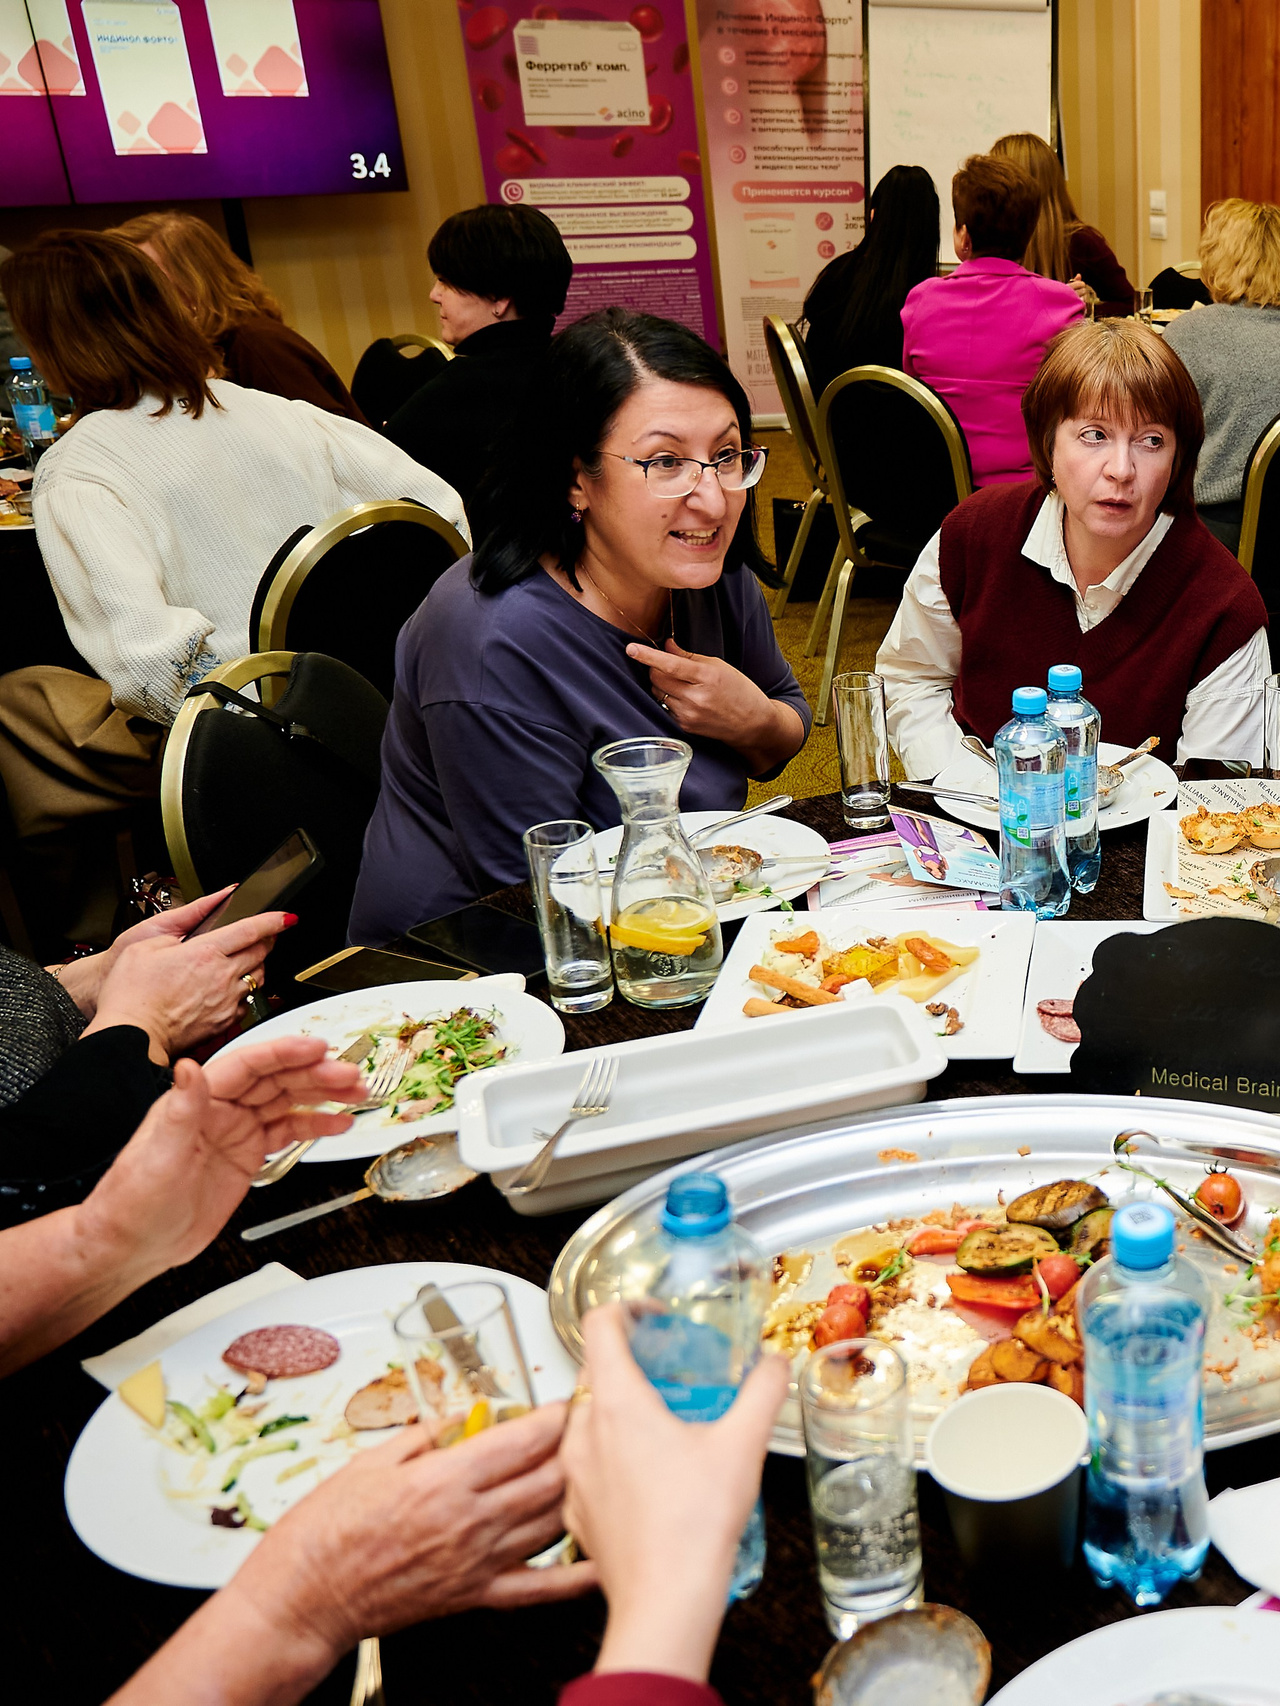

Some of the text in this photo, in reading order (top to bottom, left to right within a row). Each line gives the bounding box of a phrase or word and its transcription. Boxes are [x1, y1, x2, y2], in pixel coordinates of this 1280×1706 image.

[617, 108, 646, 119] acino
[350, 152, 392, 180] 3.4
[742, 187, 811, 198] Применяется
[1211, 784, 1245, 812] EALLIANCE
[1151, 1066, 1228, 1092] Medical
